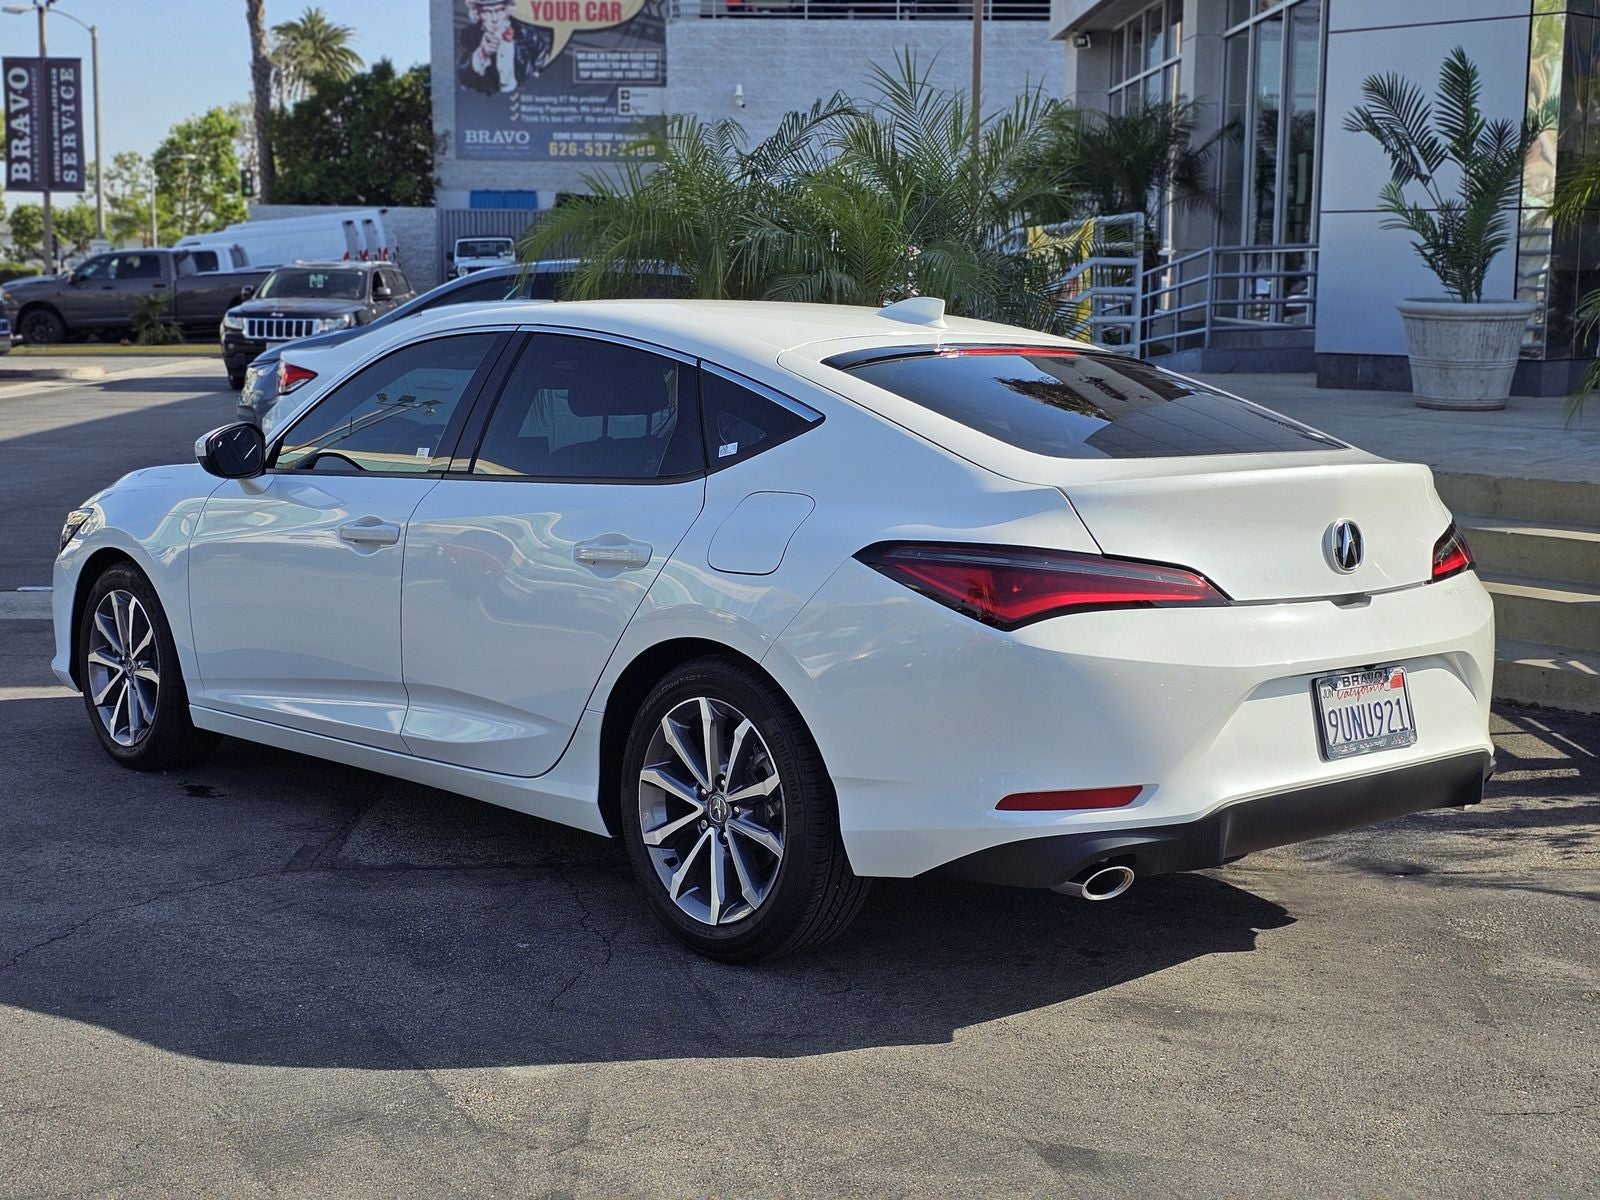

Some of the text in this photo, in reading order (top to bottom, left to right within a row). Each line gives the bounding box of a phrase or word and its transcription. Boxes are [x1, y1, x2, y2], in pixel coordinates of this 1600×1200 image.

[531, 1, 622, 22] YOUR CAR
[7, 67, 32, 182] BRAVO
[60, 67, 78, 183] SERVICE
[465, 130, 531, 144] BRAVO
[1342, 671, 1383, 688] BRAVO
[1337, 682, 1392, 702] California
[1327, 698, 1409, 745] 9UNU921
